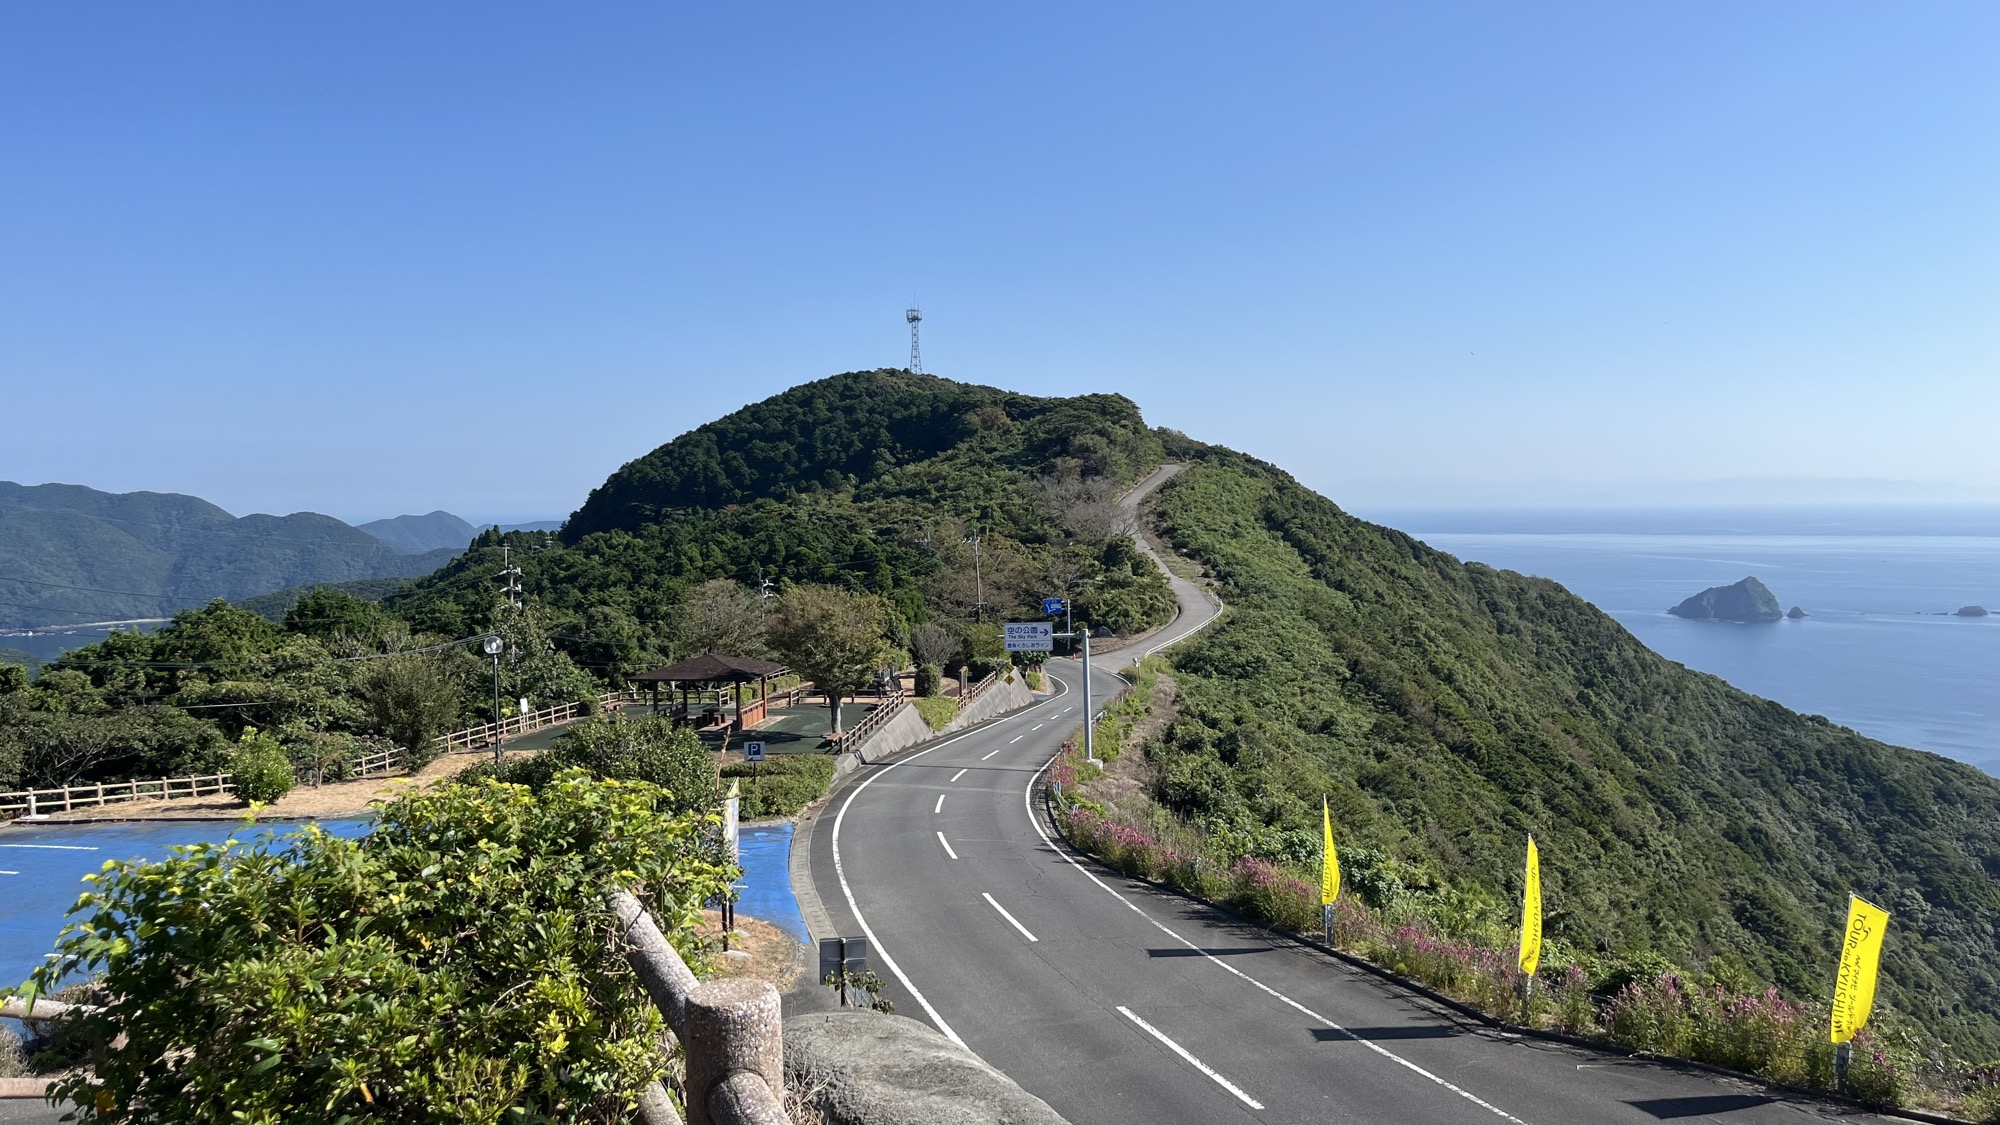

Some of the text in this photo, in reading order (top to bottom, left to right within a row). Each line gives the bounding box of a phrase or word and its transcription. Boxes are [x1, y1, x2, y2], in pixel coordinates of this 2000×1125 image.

[750, 744, 759, 755] P
[1848, 913, 1867, 949] TOUR
[1833, 962, 1851, 1018] KYUSHU
